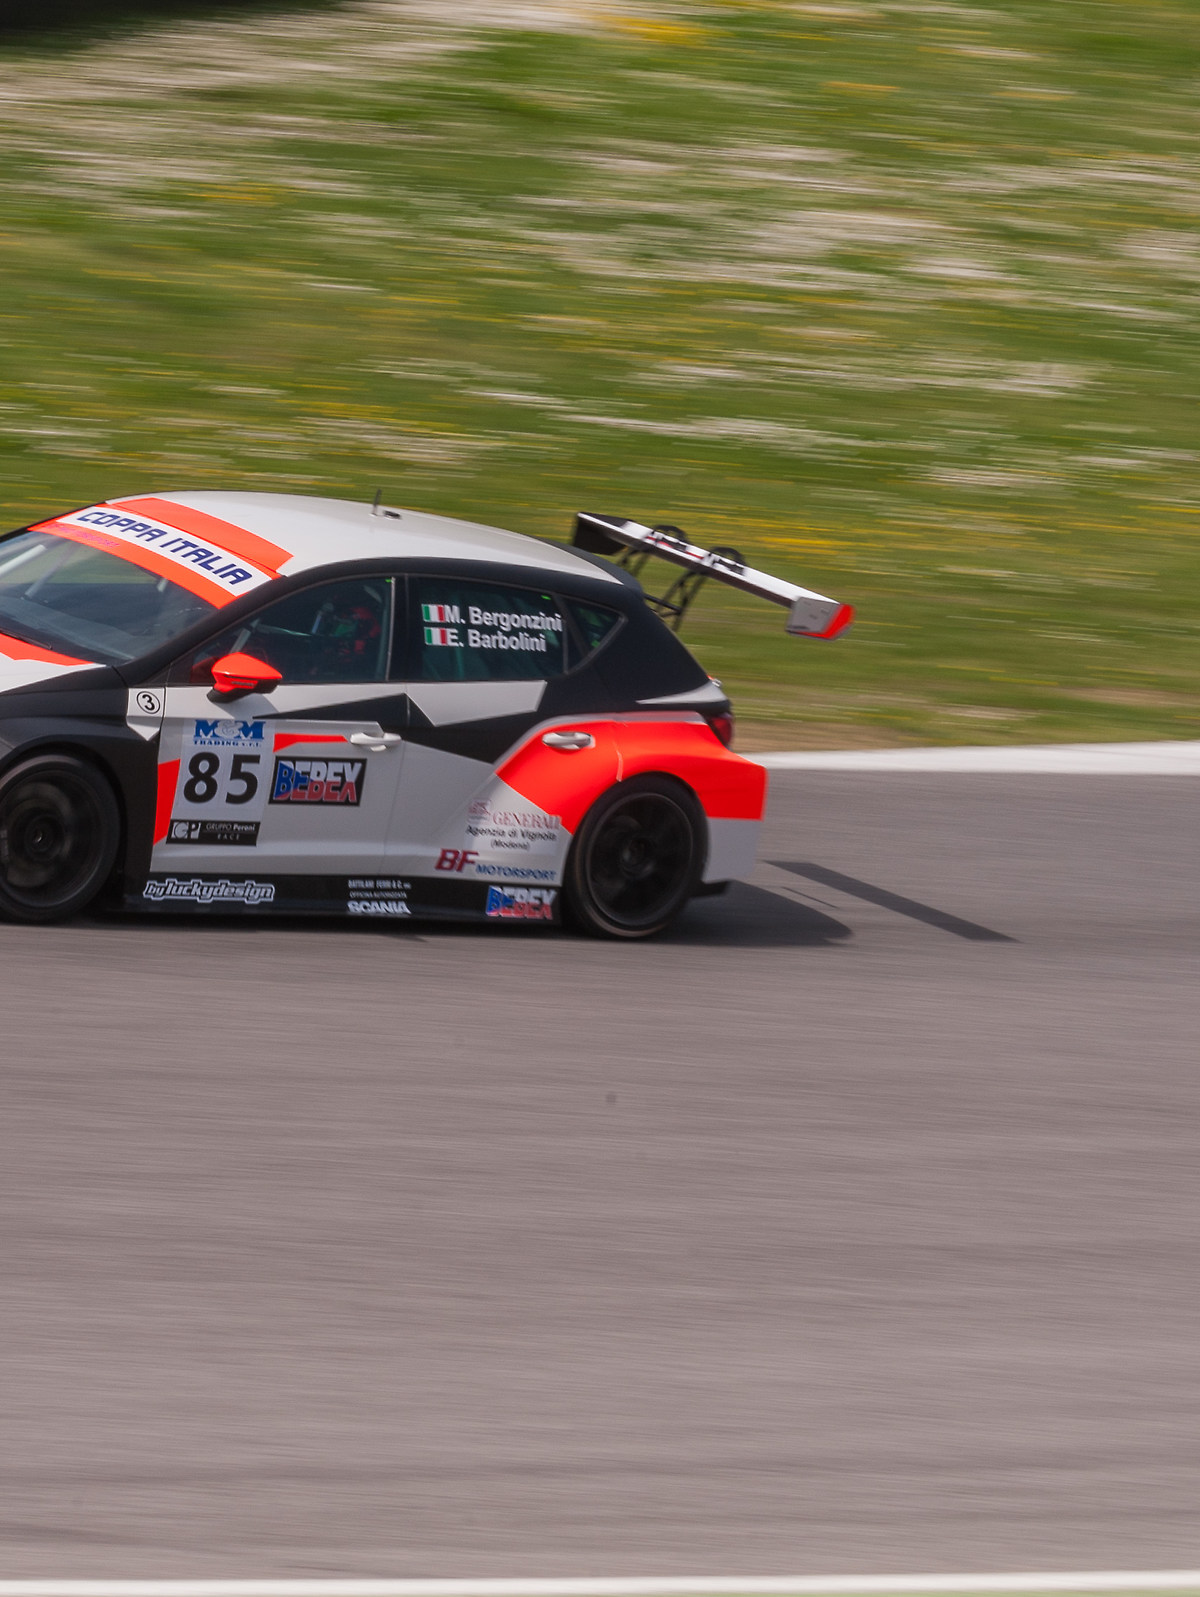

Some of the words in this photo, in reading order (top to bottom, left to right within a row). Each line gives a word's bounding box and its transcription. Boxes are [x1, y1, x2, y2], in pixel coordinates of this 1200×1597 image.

[77, 511, 167, 541] COPPA
[160, 537, 253, 585] ITALIA
[444, 604, 466, 624] M.
[468, 606, 563, 632] Bergonzini
[447, 627, 465, 648] E.
[468, 628, 547, 652] Barbolini
[183, 752, 261, 804] 85
[273, 760, 364, 803] BEBEX
[233, 823, 256, 832] Peroni
[435, 848, 479, 872] BF
[476, 864, 557, 880] MOTORSPORT
[347, 900, 412, 914] SCANIA
